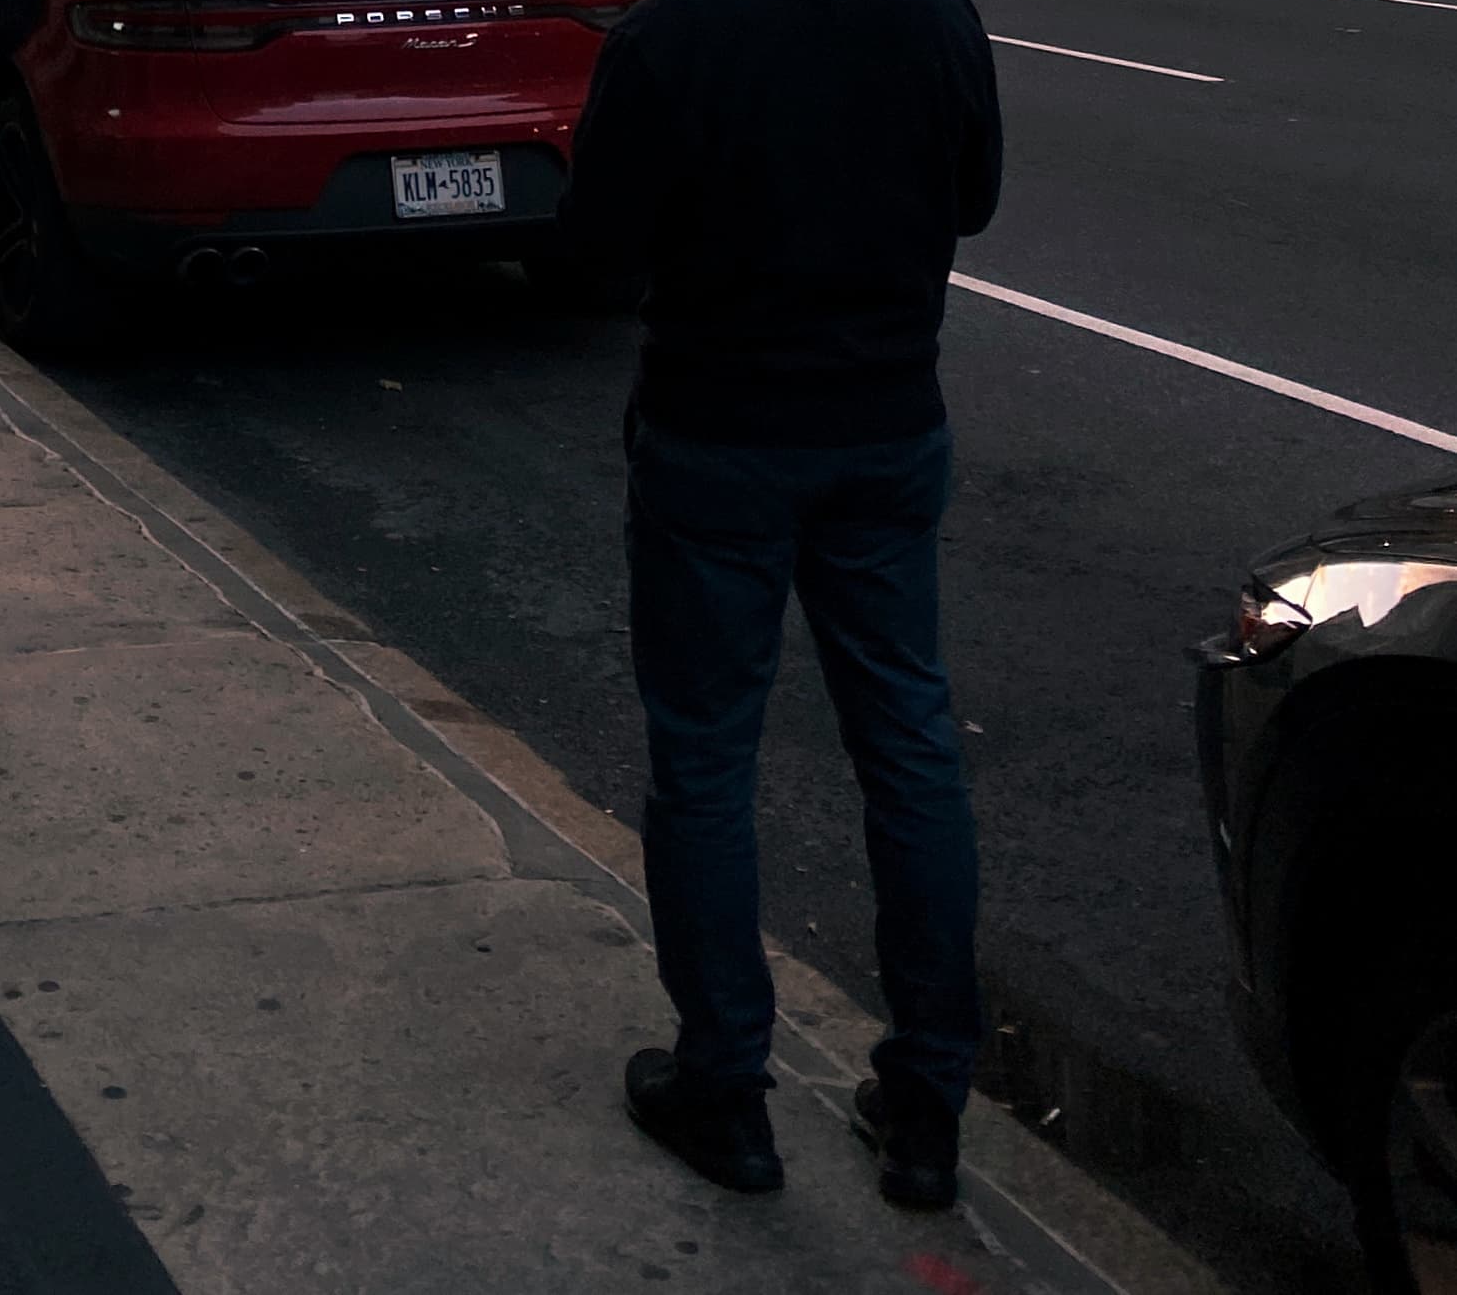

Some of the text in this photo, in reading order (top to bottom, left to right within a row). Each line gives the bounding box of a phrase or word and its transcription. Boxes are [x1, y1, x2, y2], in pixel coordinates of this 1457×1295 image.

[337, 5, 523, 25] PORSCHE
[401, 37, 457, 50] Macan
[403, 167, 495, 202] KLM 5835
